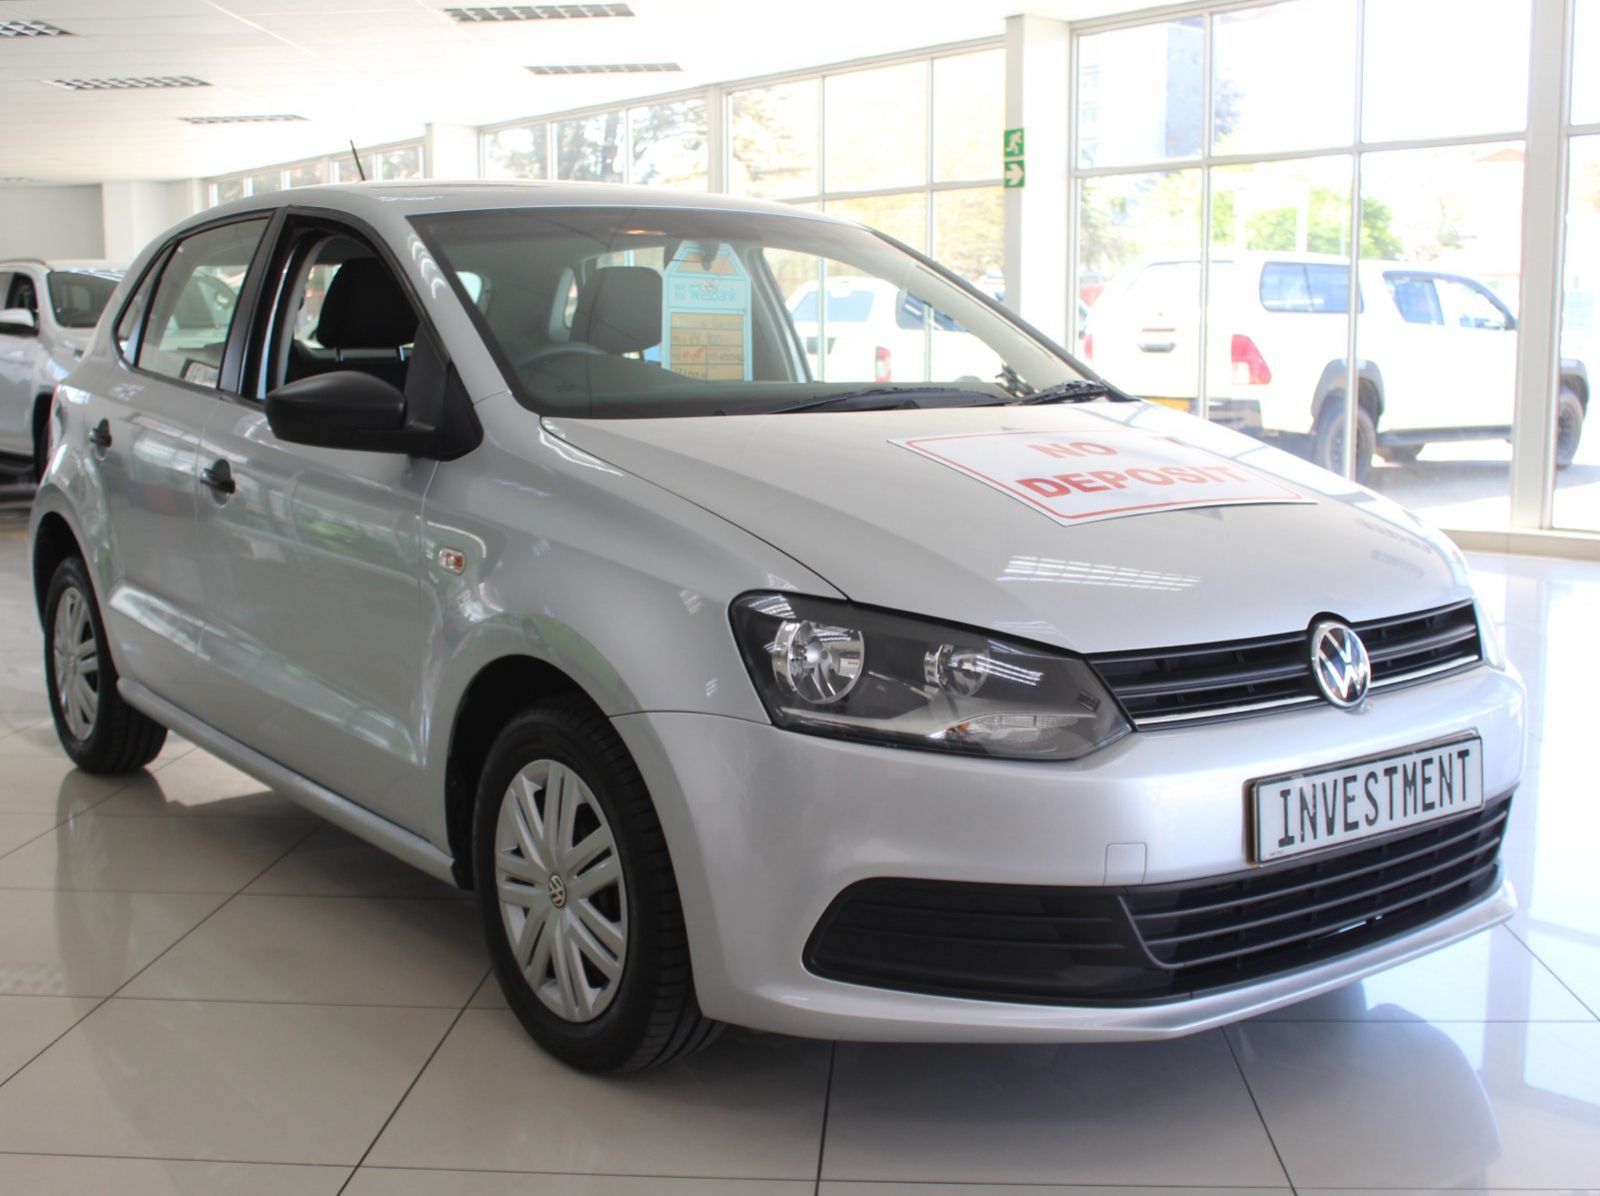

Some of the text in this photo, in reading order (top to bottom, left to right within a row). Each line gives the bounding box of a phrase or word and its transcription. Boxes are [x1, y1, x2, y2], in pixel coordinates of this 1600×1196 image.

[1027, 441, 1118, 459] NO
[1014, 466, 1247, 498] DEPOSIT
[1278, 748, 1470, 848] INVESTMENT
